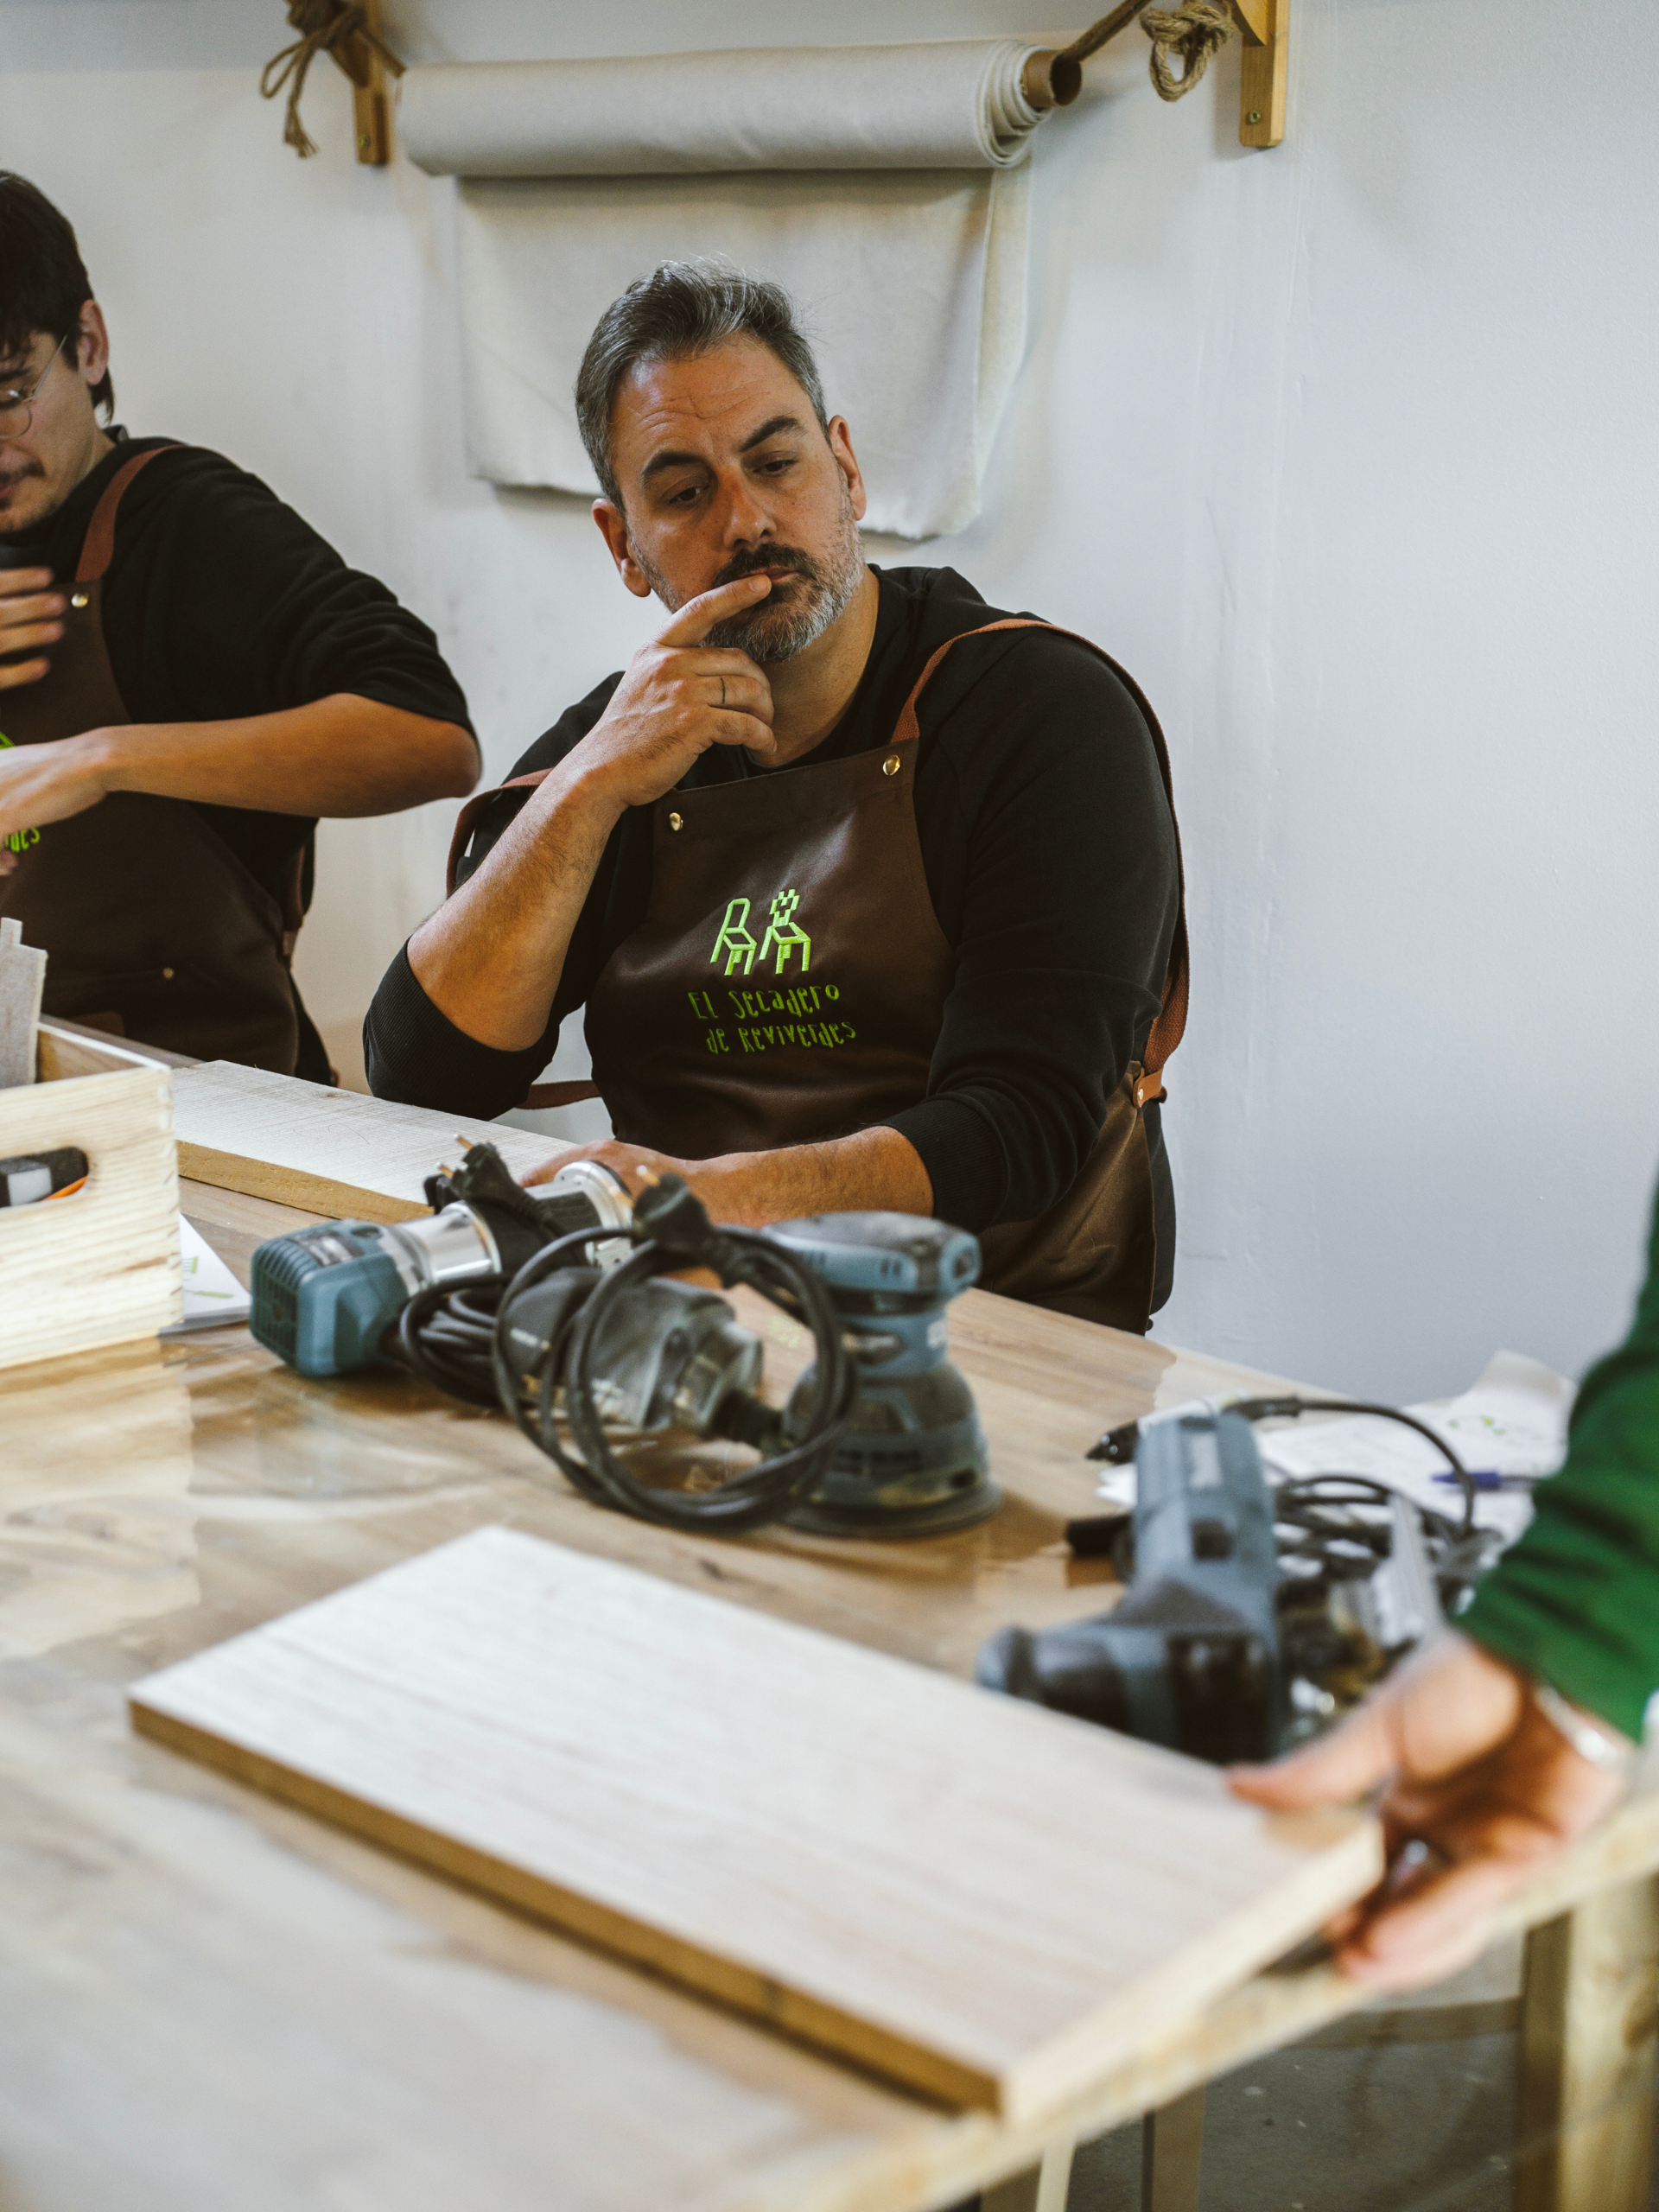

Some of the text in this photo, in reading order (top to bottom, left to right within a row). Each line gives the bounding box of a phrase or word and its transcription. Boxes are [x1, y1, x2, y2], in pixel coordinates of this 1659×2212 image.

[728, 984, 840, 1019] Secadero
[706, 1021, 856, 1055] de Reviverdes
